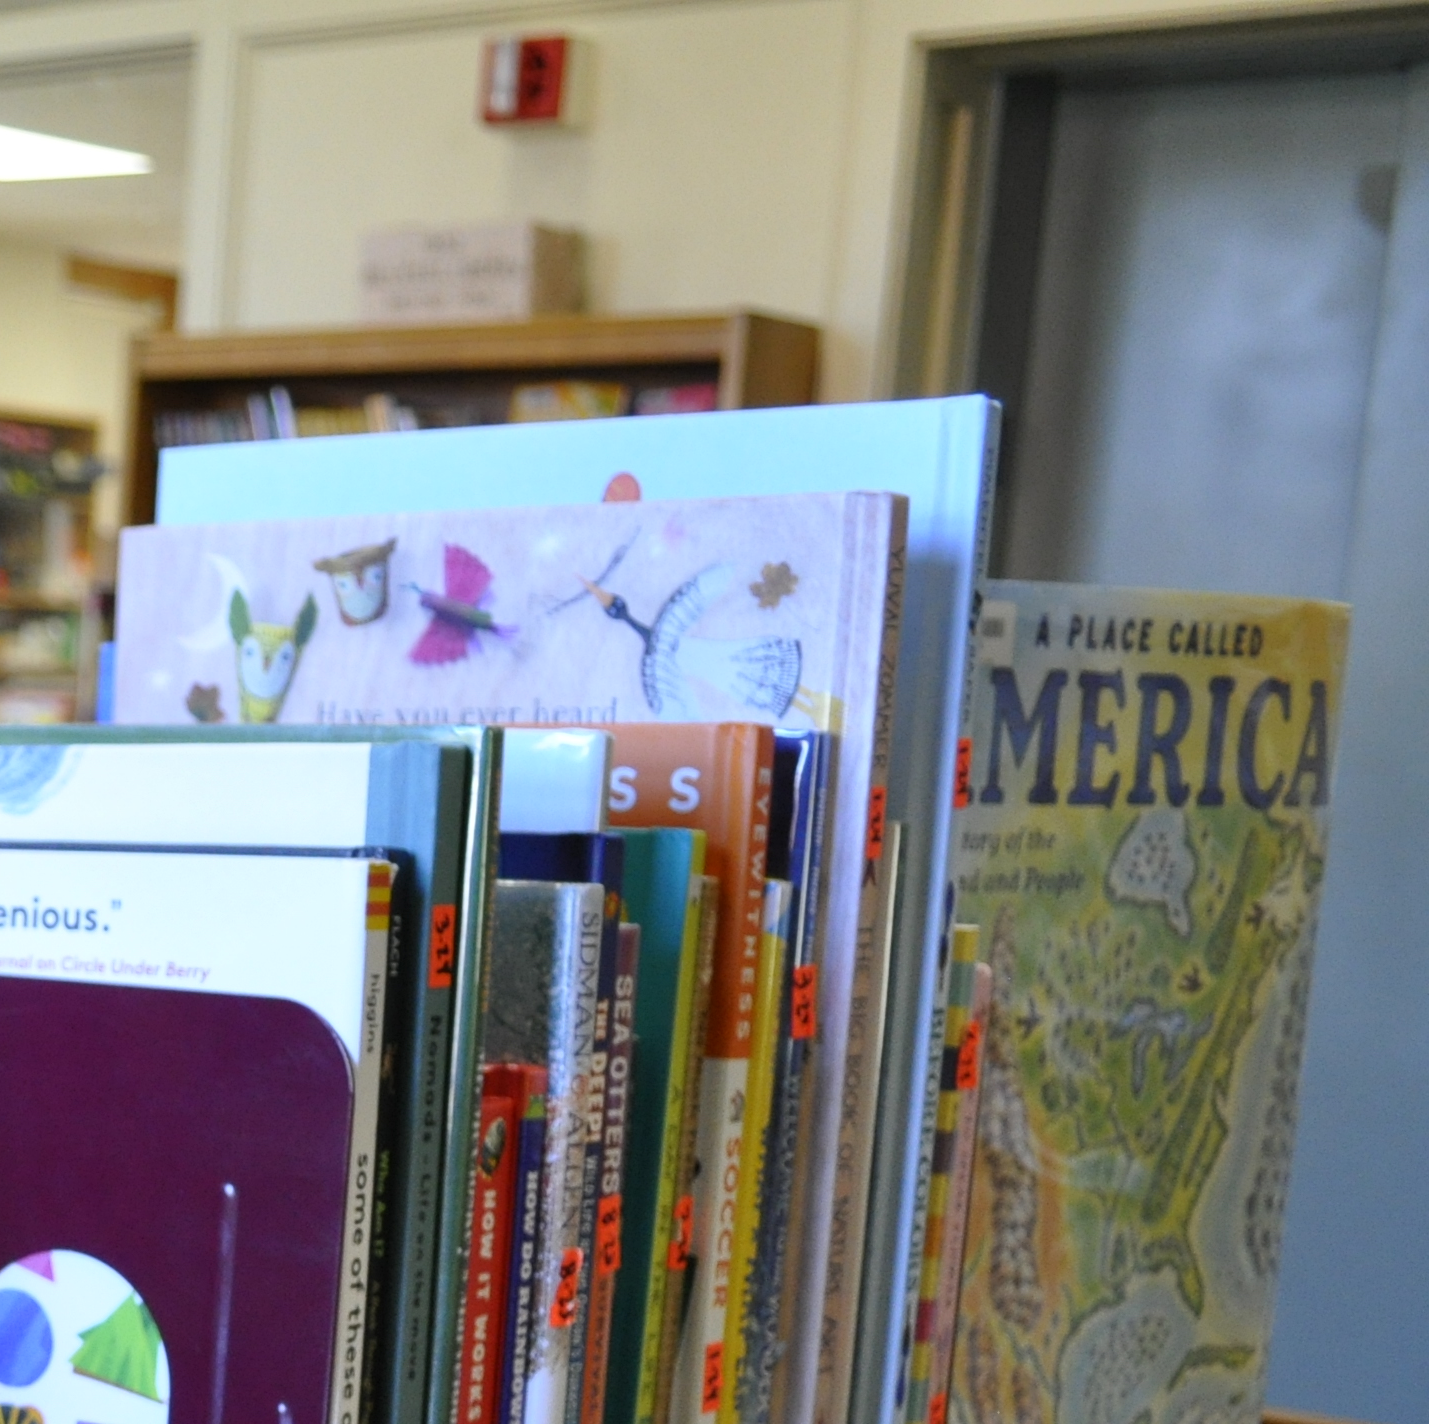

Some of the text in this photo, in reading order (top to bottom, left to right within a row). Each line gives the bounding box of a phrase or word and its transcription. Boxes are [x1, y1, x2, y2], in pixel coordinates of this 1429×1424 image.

[1034, 612, 1264, 658] A PLACE CALLED
[317, 698, 617, 725] Have you ever heard
[977, 666, 1331, 812] MERICA
[736, 766, 773, 1041] EYEWITNESS
[36, 957, 57, 972] on
[60, 955, 106, 975] Circle
[111, 958, 161, 979] Under
[165, 961, 212, 984] Berry
[389, 915, 402, 977] FLACH
[573, 911, 602, 1058] SIDMAN
[365, 973, 381, 1055] higgins
[594, 998, 609, 1042] THE
[421, 1015, 443, 1144] Nomads
[586, 1053, 608, 1143] DEEP!
[601, 973, 635, 1195] SEA OTTERS
[351, 1152, 372, 1245] some
[478, 1187, 498, 1260] HOW
[523, 1170, 540, 1237] HOW
[712, 1136, 743, 1308] SOCCER
[348, 1256, 368, 1291] of
[475, 1271, 491, 1303] IT
[519, 1241, 537, 1281] DO
[342, 1306, 362, 1400] these
[467, 1314, 489, 1424] WORKS
